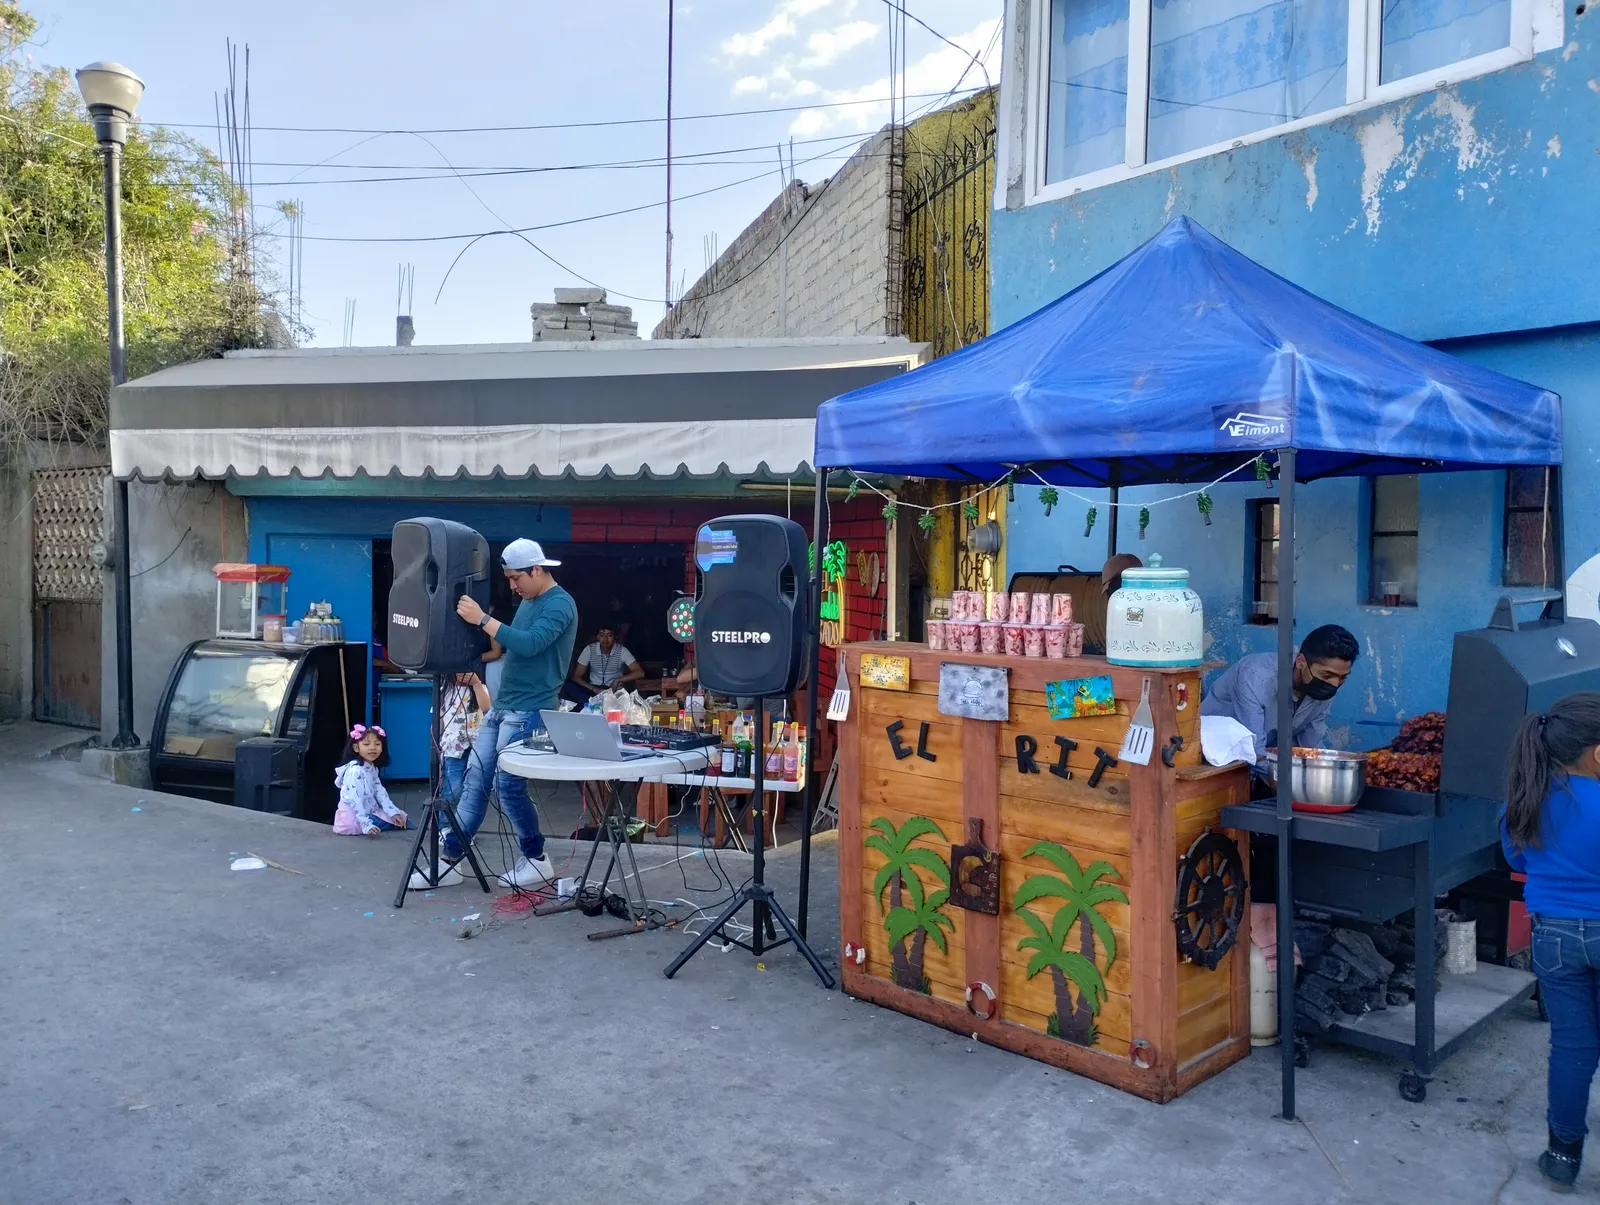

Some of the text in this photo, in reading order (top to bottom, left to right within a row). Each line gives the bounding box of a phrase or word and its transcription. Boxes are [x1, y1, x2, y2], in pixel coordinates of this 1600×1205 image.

[392, 612, 420, 629] STEELPRO
[711, 630, 771, 644] STEELPRO
[886, 720, 937, 762] EL
